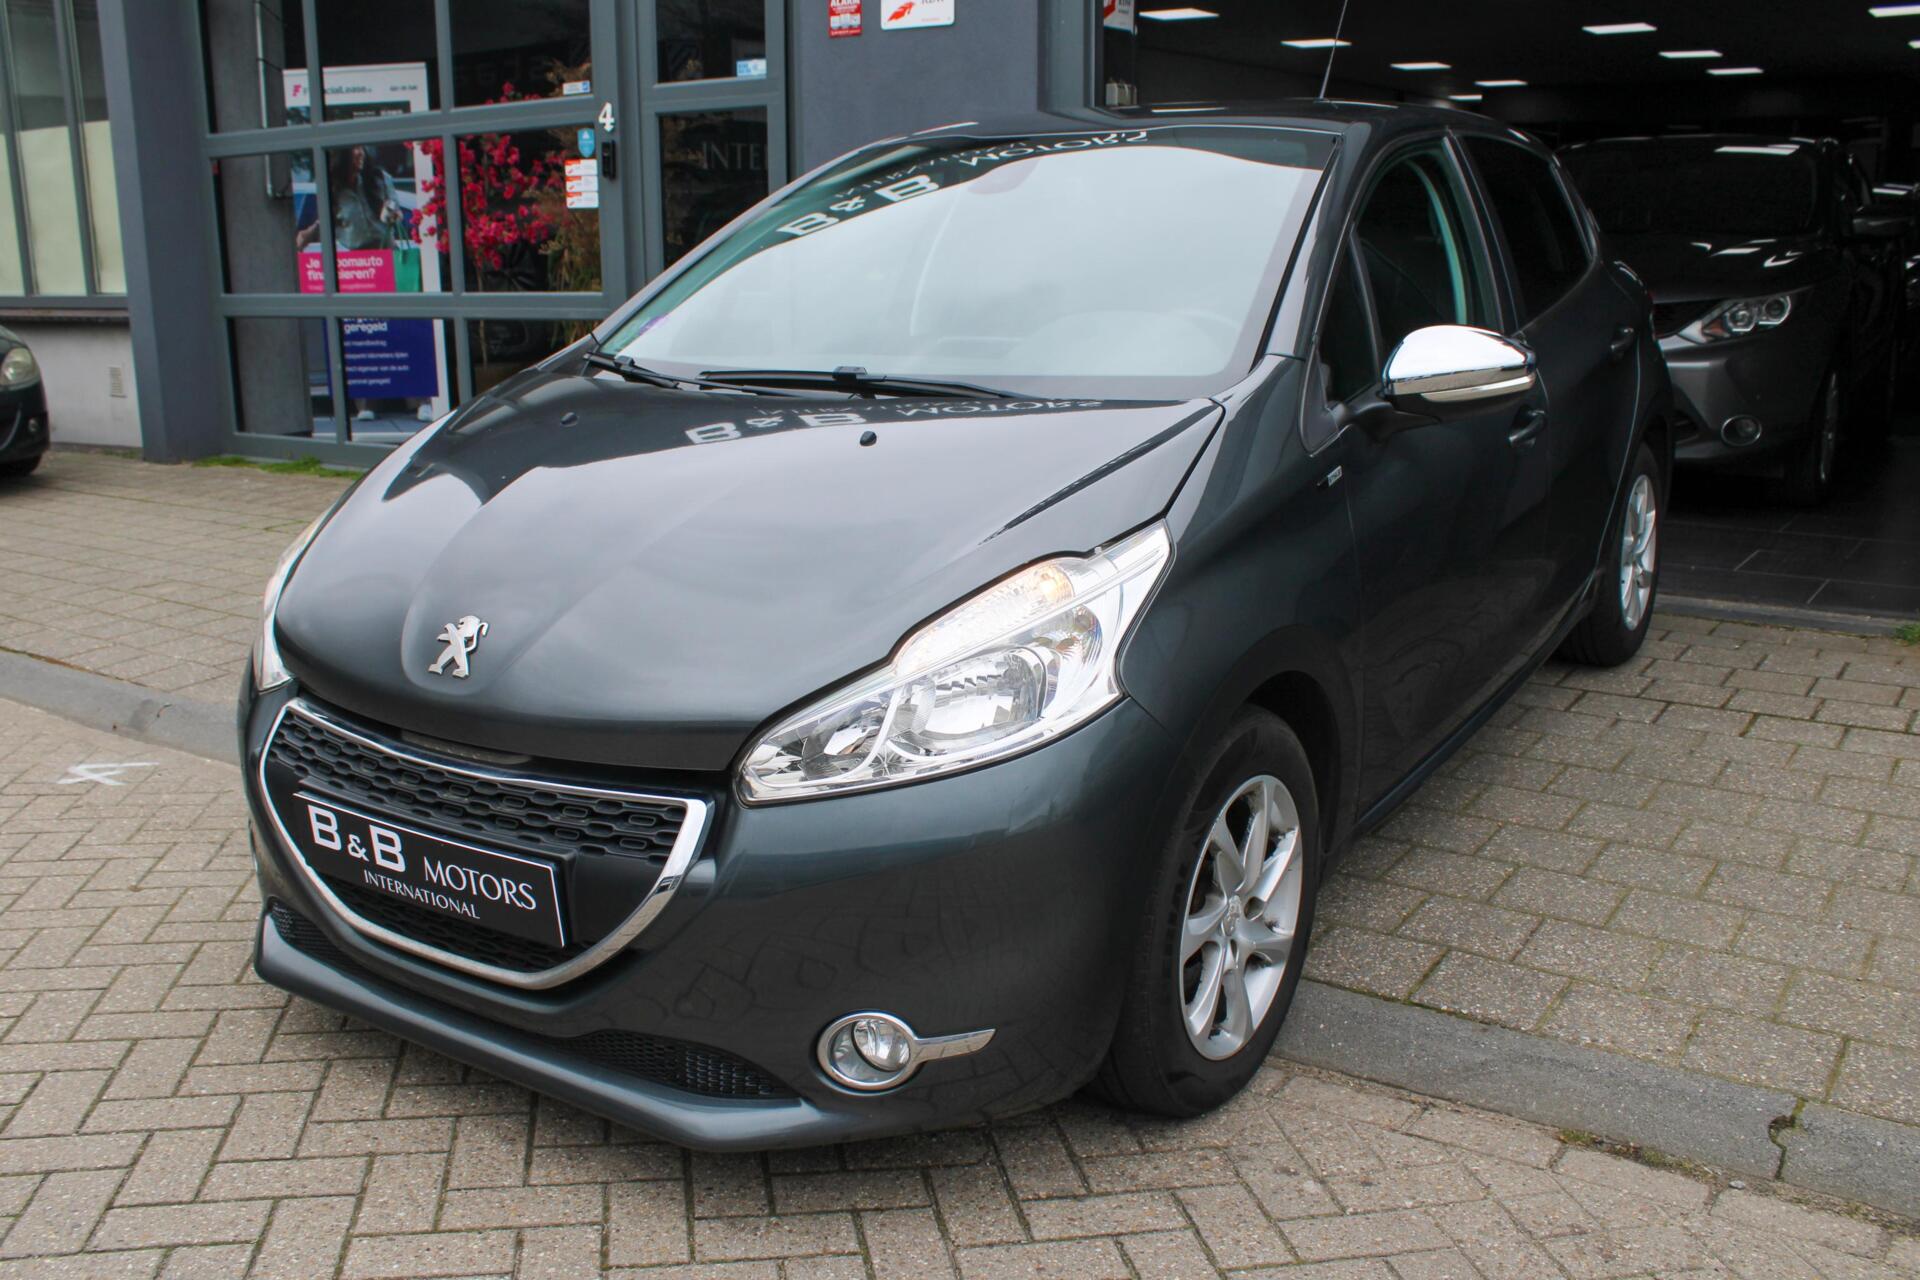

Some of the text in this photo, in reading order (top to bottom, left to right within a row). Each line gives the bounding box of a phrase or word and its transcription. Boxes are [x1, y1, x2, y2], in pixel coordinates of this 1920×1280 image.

[598, 102, 615, 132] 4
[306, 258, 320, 269] Je
[344, 321, 388, 335] geregeld
[364, 869, 480, 920] INTERNATIONAL
[424, 856, 536, 910] MOTORS
